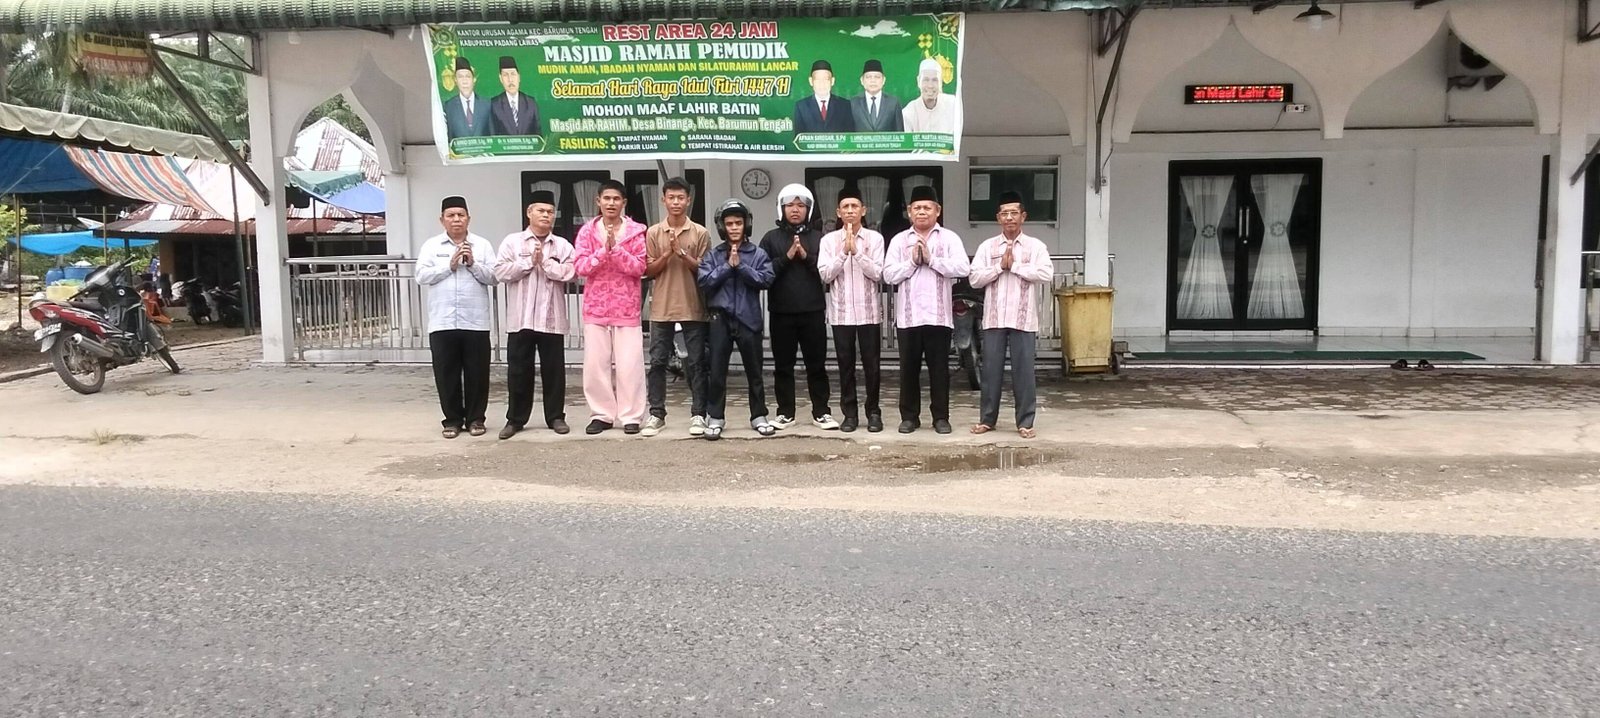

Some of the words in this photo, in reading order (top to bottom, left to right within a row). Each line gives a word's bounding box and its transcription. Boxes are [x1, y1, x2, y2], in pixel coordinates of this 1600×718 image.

[457, 29, 481, 37] KANTOR
[543, 27, 574, 35] BARUMUN
[603, 25, 651, 41] REST
[655, 24, 708, 40] AREA
[710, 22, 736, 39] 24
[738, 21, 778, 39] JAM
[460, 39, 494, 47] KABUPATEN
[543, 46, 613, 64] MASJID
[619, 43, 691, 61] RAMAH
[697, 42, 789, 59] PEMUDIK
[538, 65, 568, 74] MUDIK
[569, 65, 599, 75] AMAN,
[600, 64, 635, 73] IBADAH
[637, 63, 675, 73] NYAMAN
[678, 62, 697, 72] DAN
[698, 62, 759, 72] SILATURAHMI
[761, 61, 798, 71] LANCAR
[552, 78, 607, 98] Selamat
[607, 77, 641, 98] Hari
[641, 77, 680, 100] Raya
[680, 76, 711, 96] Idul
[712, 76, 741, 96] Fitri
[741, 75, 776, 96] 1447
[775, 75, 791, 96] H
[1207, 88, 1235, 98] Maaf
[1238, 87, 1264, 98] Lahir
[582, 104, 634, 116] MOHON
[637, 103, 676, 115] MAAF
[679, 103, 719, 114] LAHIR
[721, 103, 760, 115] BATIN
[550, 118, 581, 134] Masjid
[631, 117, 656, 131] Desa
[656, 116, 696, 132] Binanga,
[697, 116, 718, 130] Kec.
[718, 117, 759, 131] Barumun
[759, 117, 793, 133] Tengah
[560, 138, 608, 149] FASILITAS:
